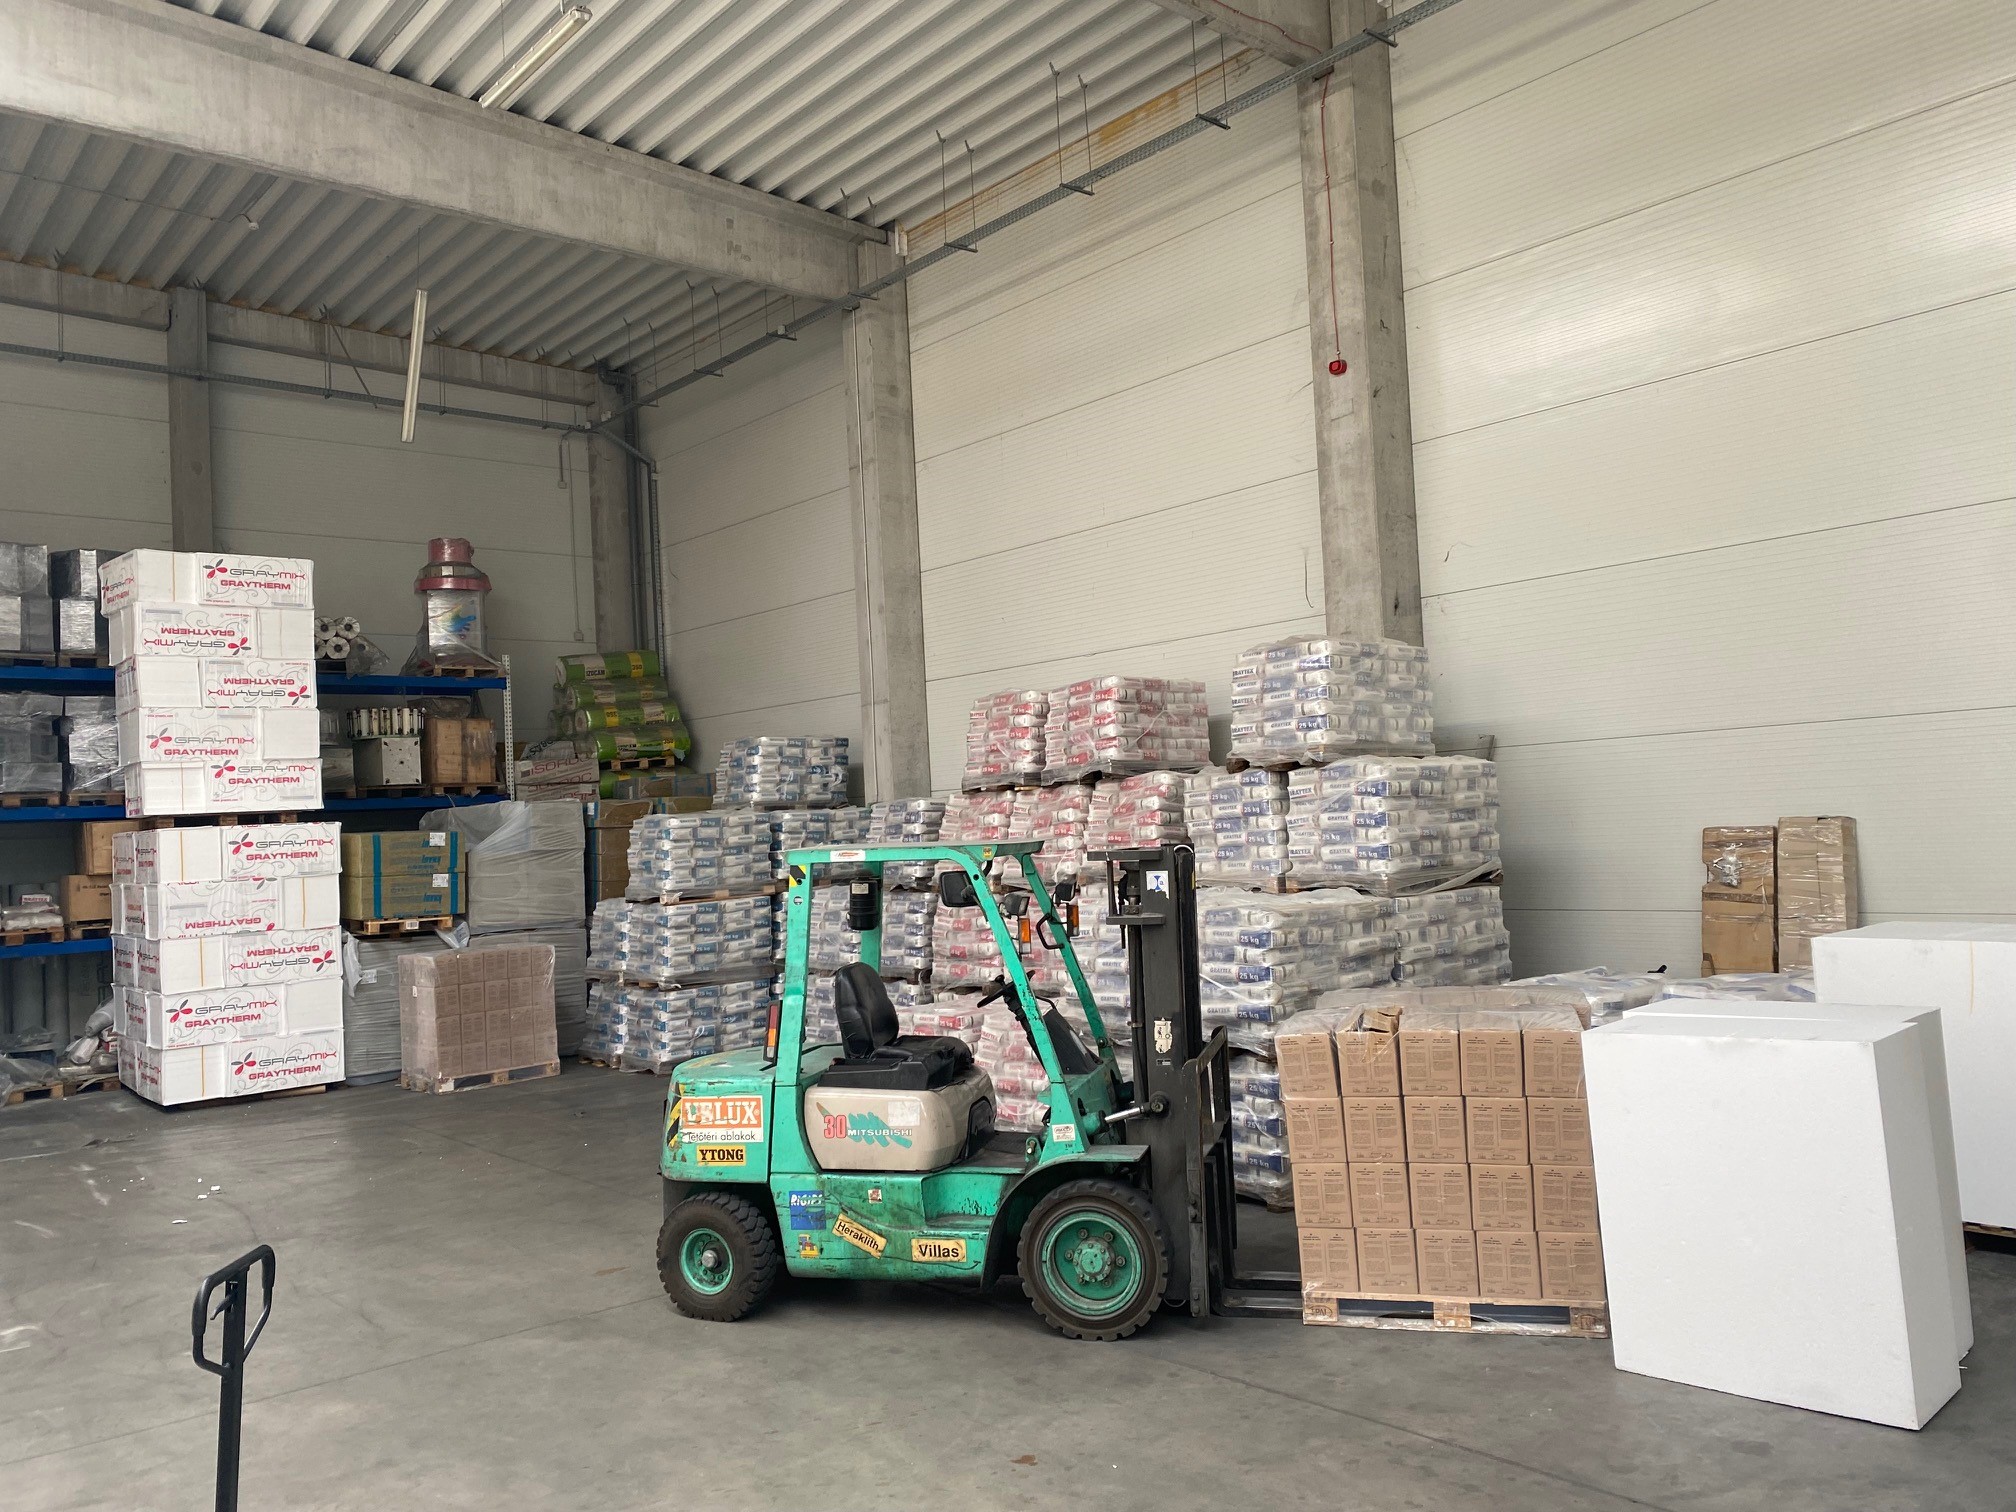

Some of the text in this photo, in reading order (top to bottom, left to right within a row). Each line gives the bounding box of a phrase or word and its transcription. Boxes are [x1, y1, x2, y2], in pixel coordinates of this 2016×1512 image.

[221, 580, 291, 590] GRAYTHERM
[161, 628, 235, 636] GRAYTHERM
[1367, 785, 1375, 793] kg
[246, 852, 318, 861] GRAYTHERM
[185, 918, 261, 929] GRAYTHERM
[1250, 936, 1259, 944] kg
[247, 945, 319, 956] GRAYTHERM
[185, 1014, 261, 1028] GRAYTHERM
[249, 1065, 321, 1080] GRAYTHERM
[1260, 1086, 1268, 1094] kg
[685, 1102, 757, 1125] VELUX
[824, 1115, 846, 1138] 30
[721, 1131, 755, 1140] ablakok
[699, 1149, 743, 1160] YTONG
[837, 1221, 879, 1250] Heraklith
[919, 1245, 959, 1257] Villas
